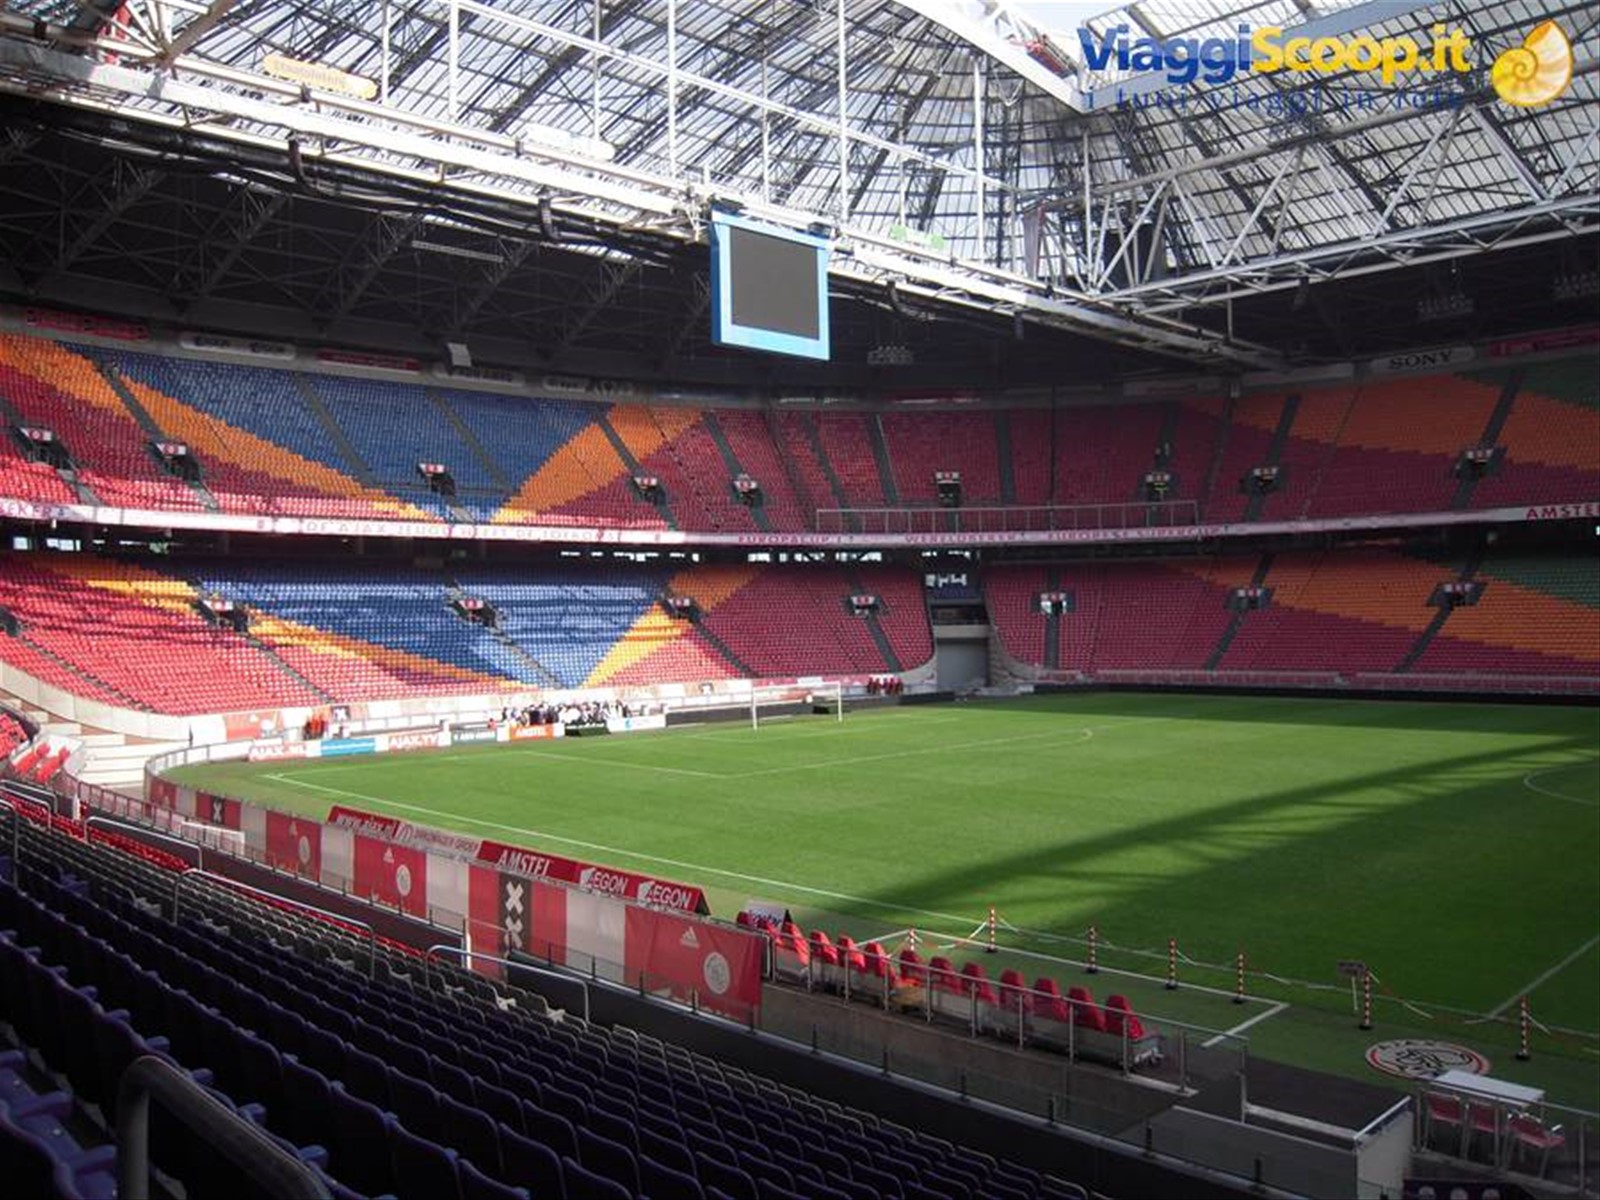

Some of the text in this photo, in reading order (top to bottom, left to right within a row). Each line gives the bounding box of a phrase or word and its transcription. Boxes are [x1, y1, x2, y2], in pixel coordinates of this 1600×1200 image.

[1390, 349, 1452, 370] SONY
[1527, 503, 1600, 519] AMSTE
[496, 849, 551, 877] AMSTEL
[645, 884, 693, 910] AEGON
